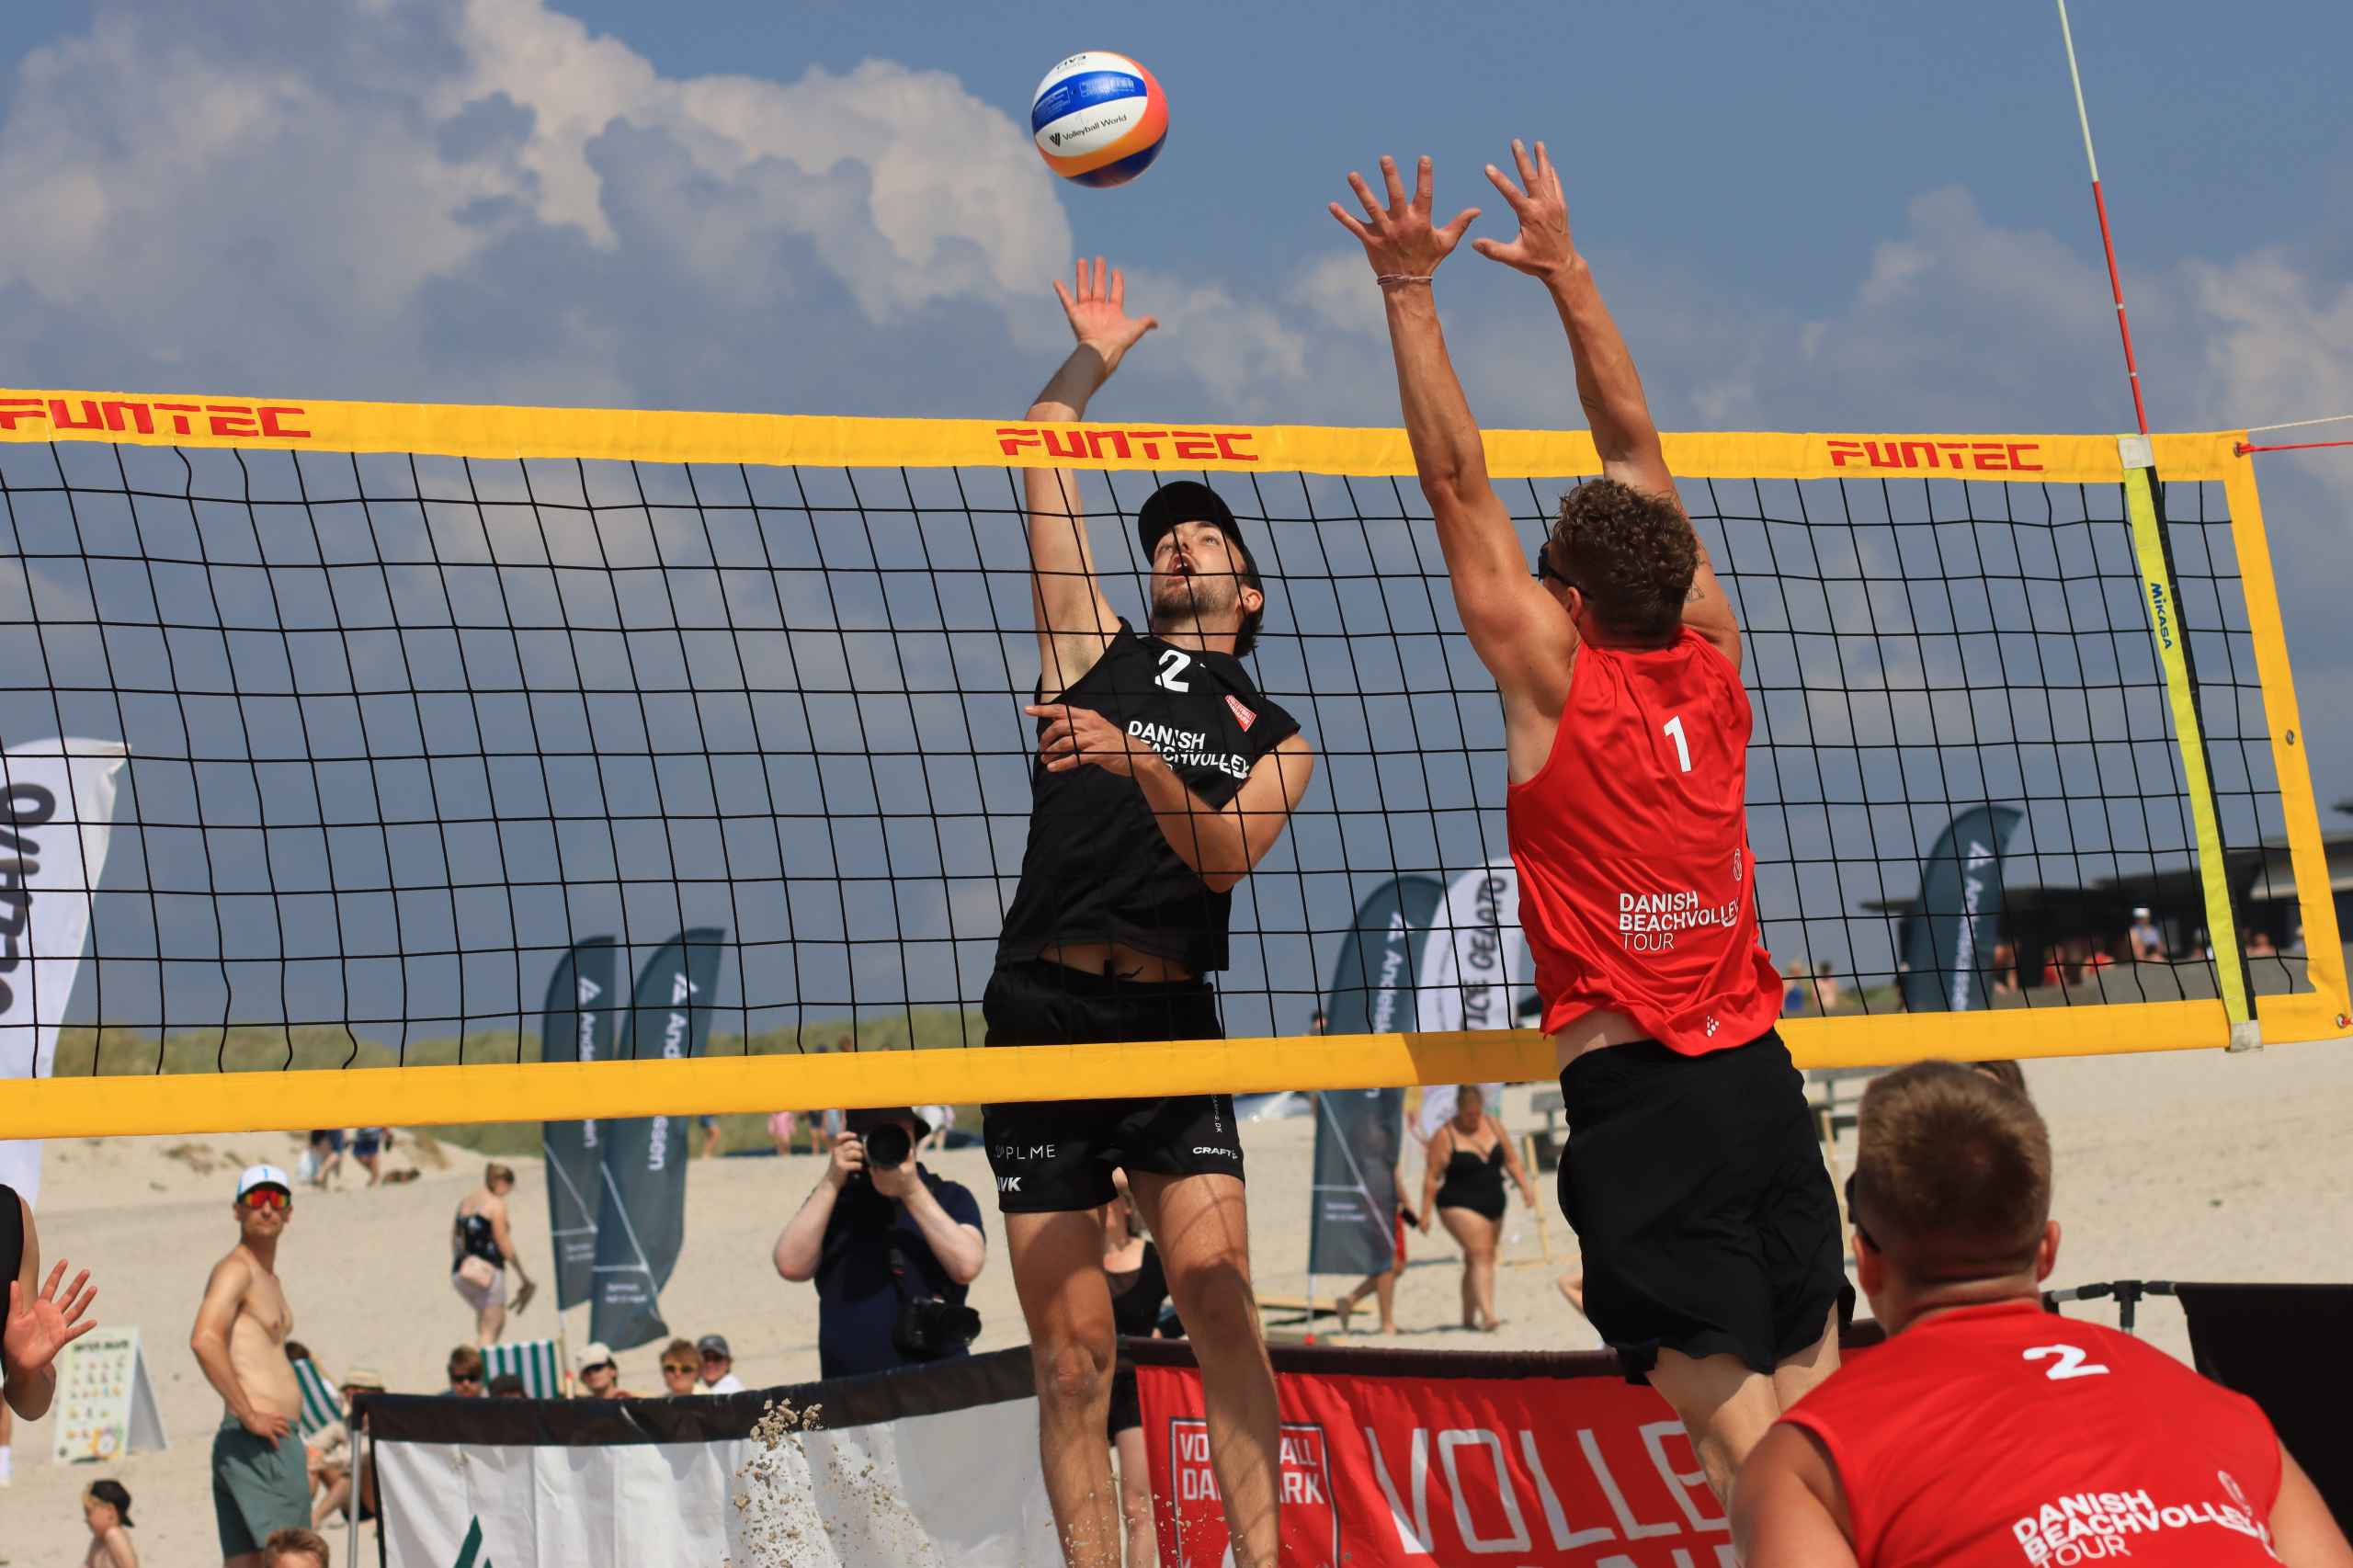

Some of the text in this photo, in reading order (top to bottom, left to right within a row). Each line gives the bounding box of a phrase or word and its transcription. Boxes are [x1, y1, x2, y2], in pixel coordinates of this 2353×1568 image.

[1062, 114, 1128, 141] Volleyball World
[0, 399, 311, 438] FUNTEC
[996, 428, 1259, 461] FUNTEC
[1826, 441, 2044, 471] FUNTEC
[1154, 649, 1192, 692] 2
[1128, 721, 1206, 750] DANISH
[1663, 715, 1691, 772] 1
[1140, 739, 1250, 774] ACHVOLLEY
[1620, 891, 1699, 914] DANISH
[1620, 933, 1675, 950] TOUR
[1192, 1146, 1232, 1157] CRAFT
[2022, 1344, 2110, 1381] 2
[2012, 1489, 2155, 1545] DANISH
[2034, 1535, 2132, 1568] TOUR
